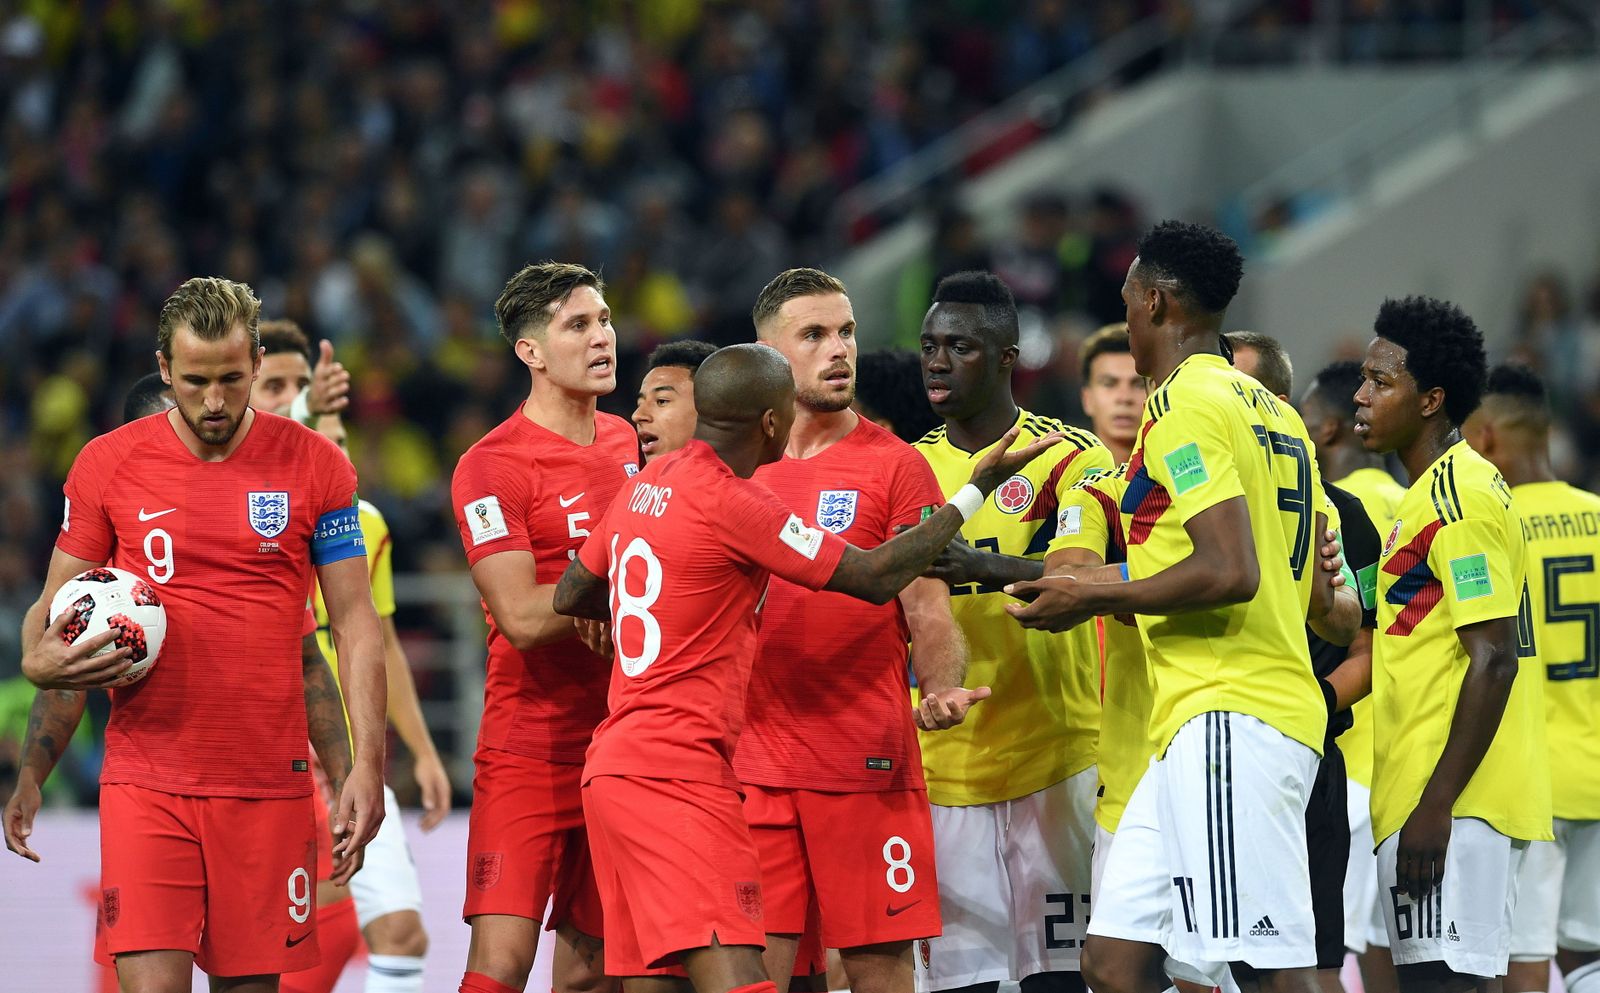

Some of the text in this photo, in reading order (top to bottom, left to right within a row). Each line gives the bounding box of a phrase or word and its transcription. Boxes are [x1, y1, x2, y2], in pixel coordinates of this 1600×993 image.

[627, 481, 672, 517] YOUNG
[313, 522, 361, 539] FOOTBAL
[314, 514, 359, 532] IVIN
[143, 528, 174, 584] 9
[1542, 555, 1600, 682] 5
[882, 836, 915, 893] 8
[287, 867, 310, 924] 9
[1248, 928, 1280, 937] adidas
